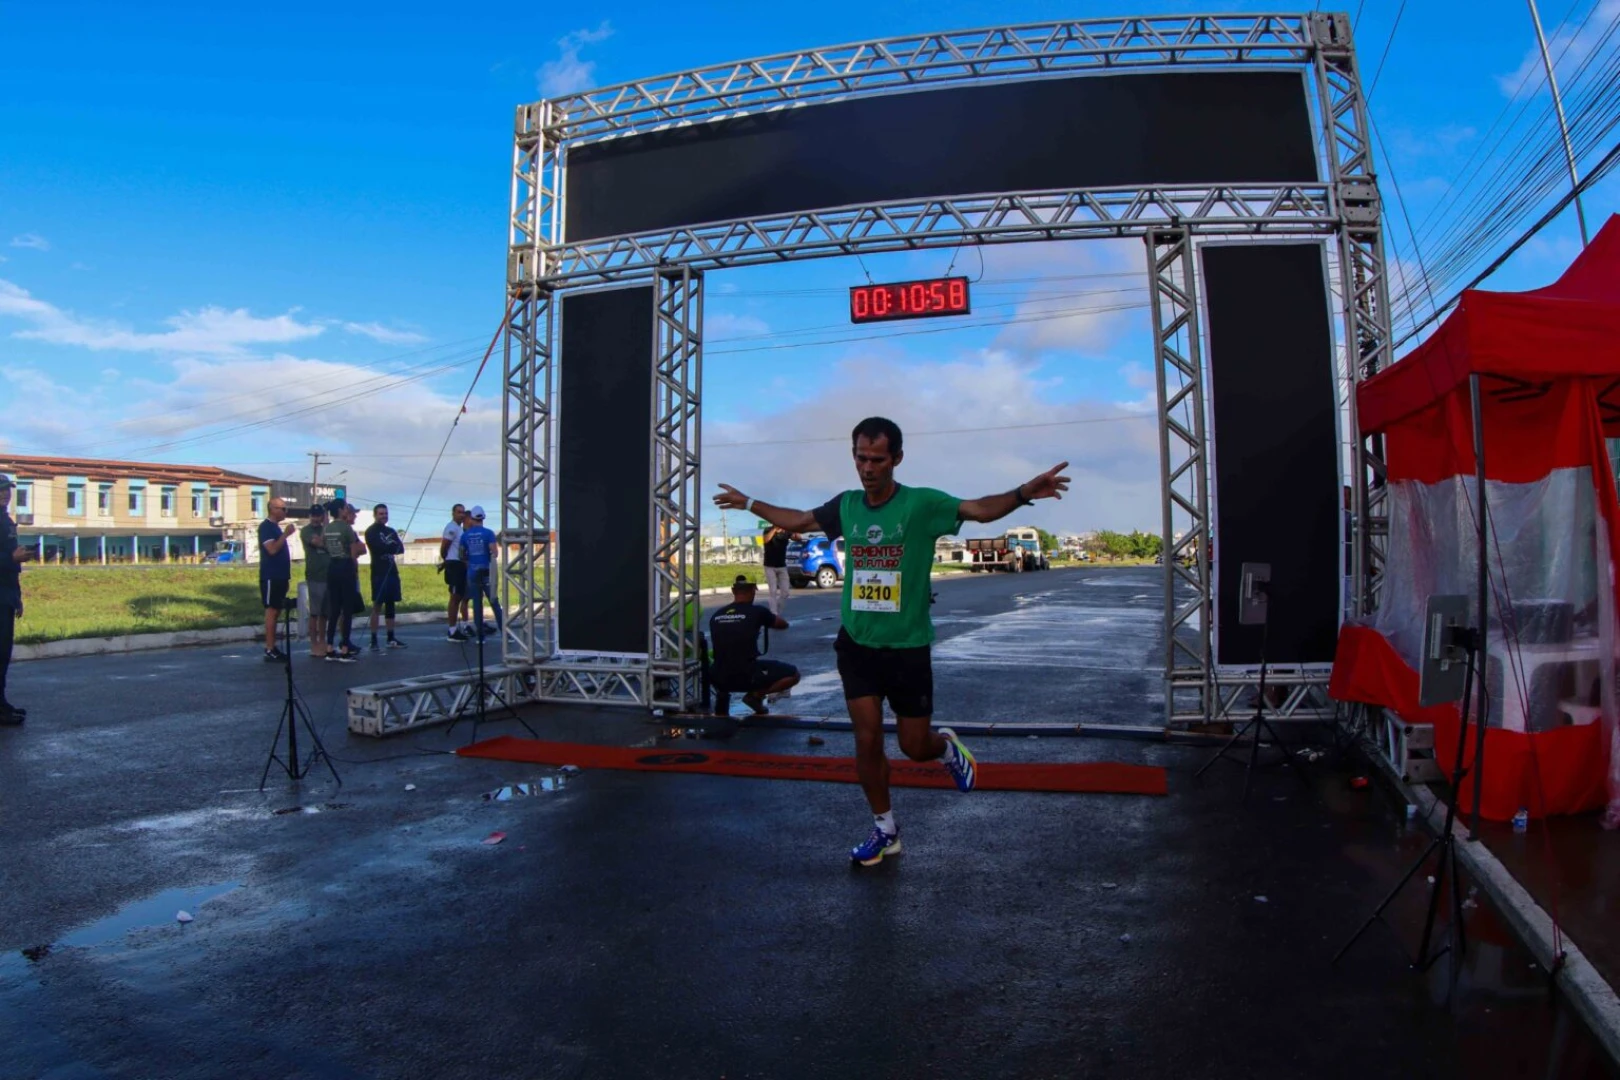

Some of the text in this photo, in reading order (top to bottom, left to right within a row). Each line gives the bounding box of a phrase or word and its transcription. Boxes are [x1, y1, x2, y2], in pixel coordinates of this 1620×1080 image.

[854, 279, 965, 317] 00:10:58
[867, 529, 882, 539] SF
[851, 545, 904, 557] SEMENTES
[853, 559, 900, 569] DO FUTURO
[859, 585, 891, 600] 3210
